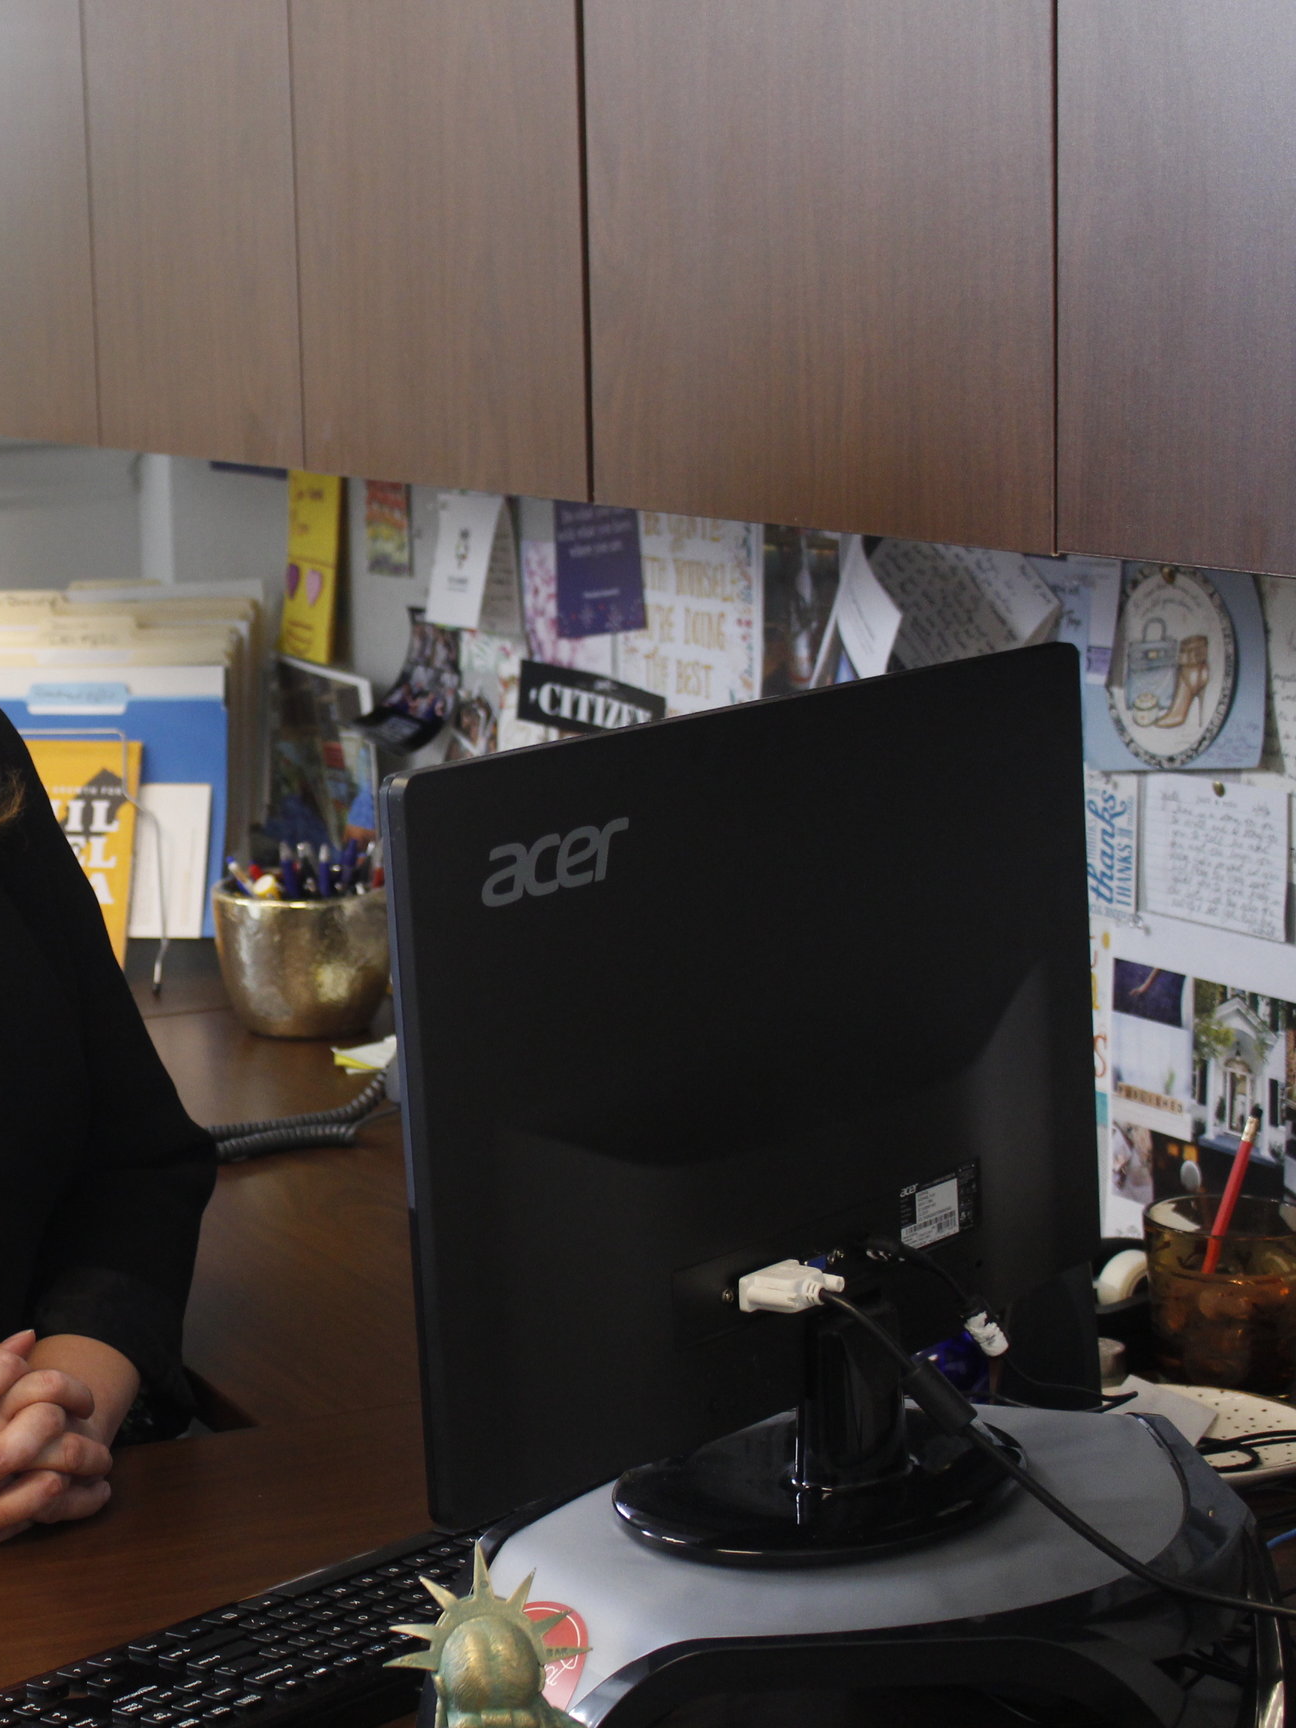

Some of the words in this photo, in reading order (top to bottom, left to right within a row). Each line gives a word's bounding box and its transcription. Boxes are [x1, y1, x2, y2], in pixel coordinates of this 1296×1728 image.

[675, 657, 715, 700] BEST
[481, 817, 629, 907] acer
[1087, 790, 1128, 904] thanks
[1116, 842, 1133, 907] THANKS
[899, 1183, 919, 1198] acer
